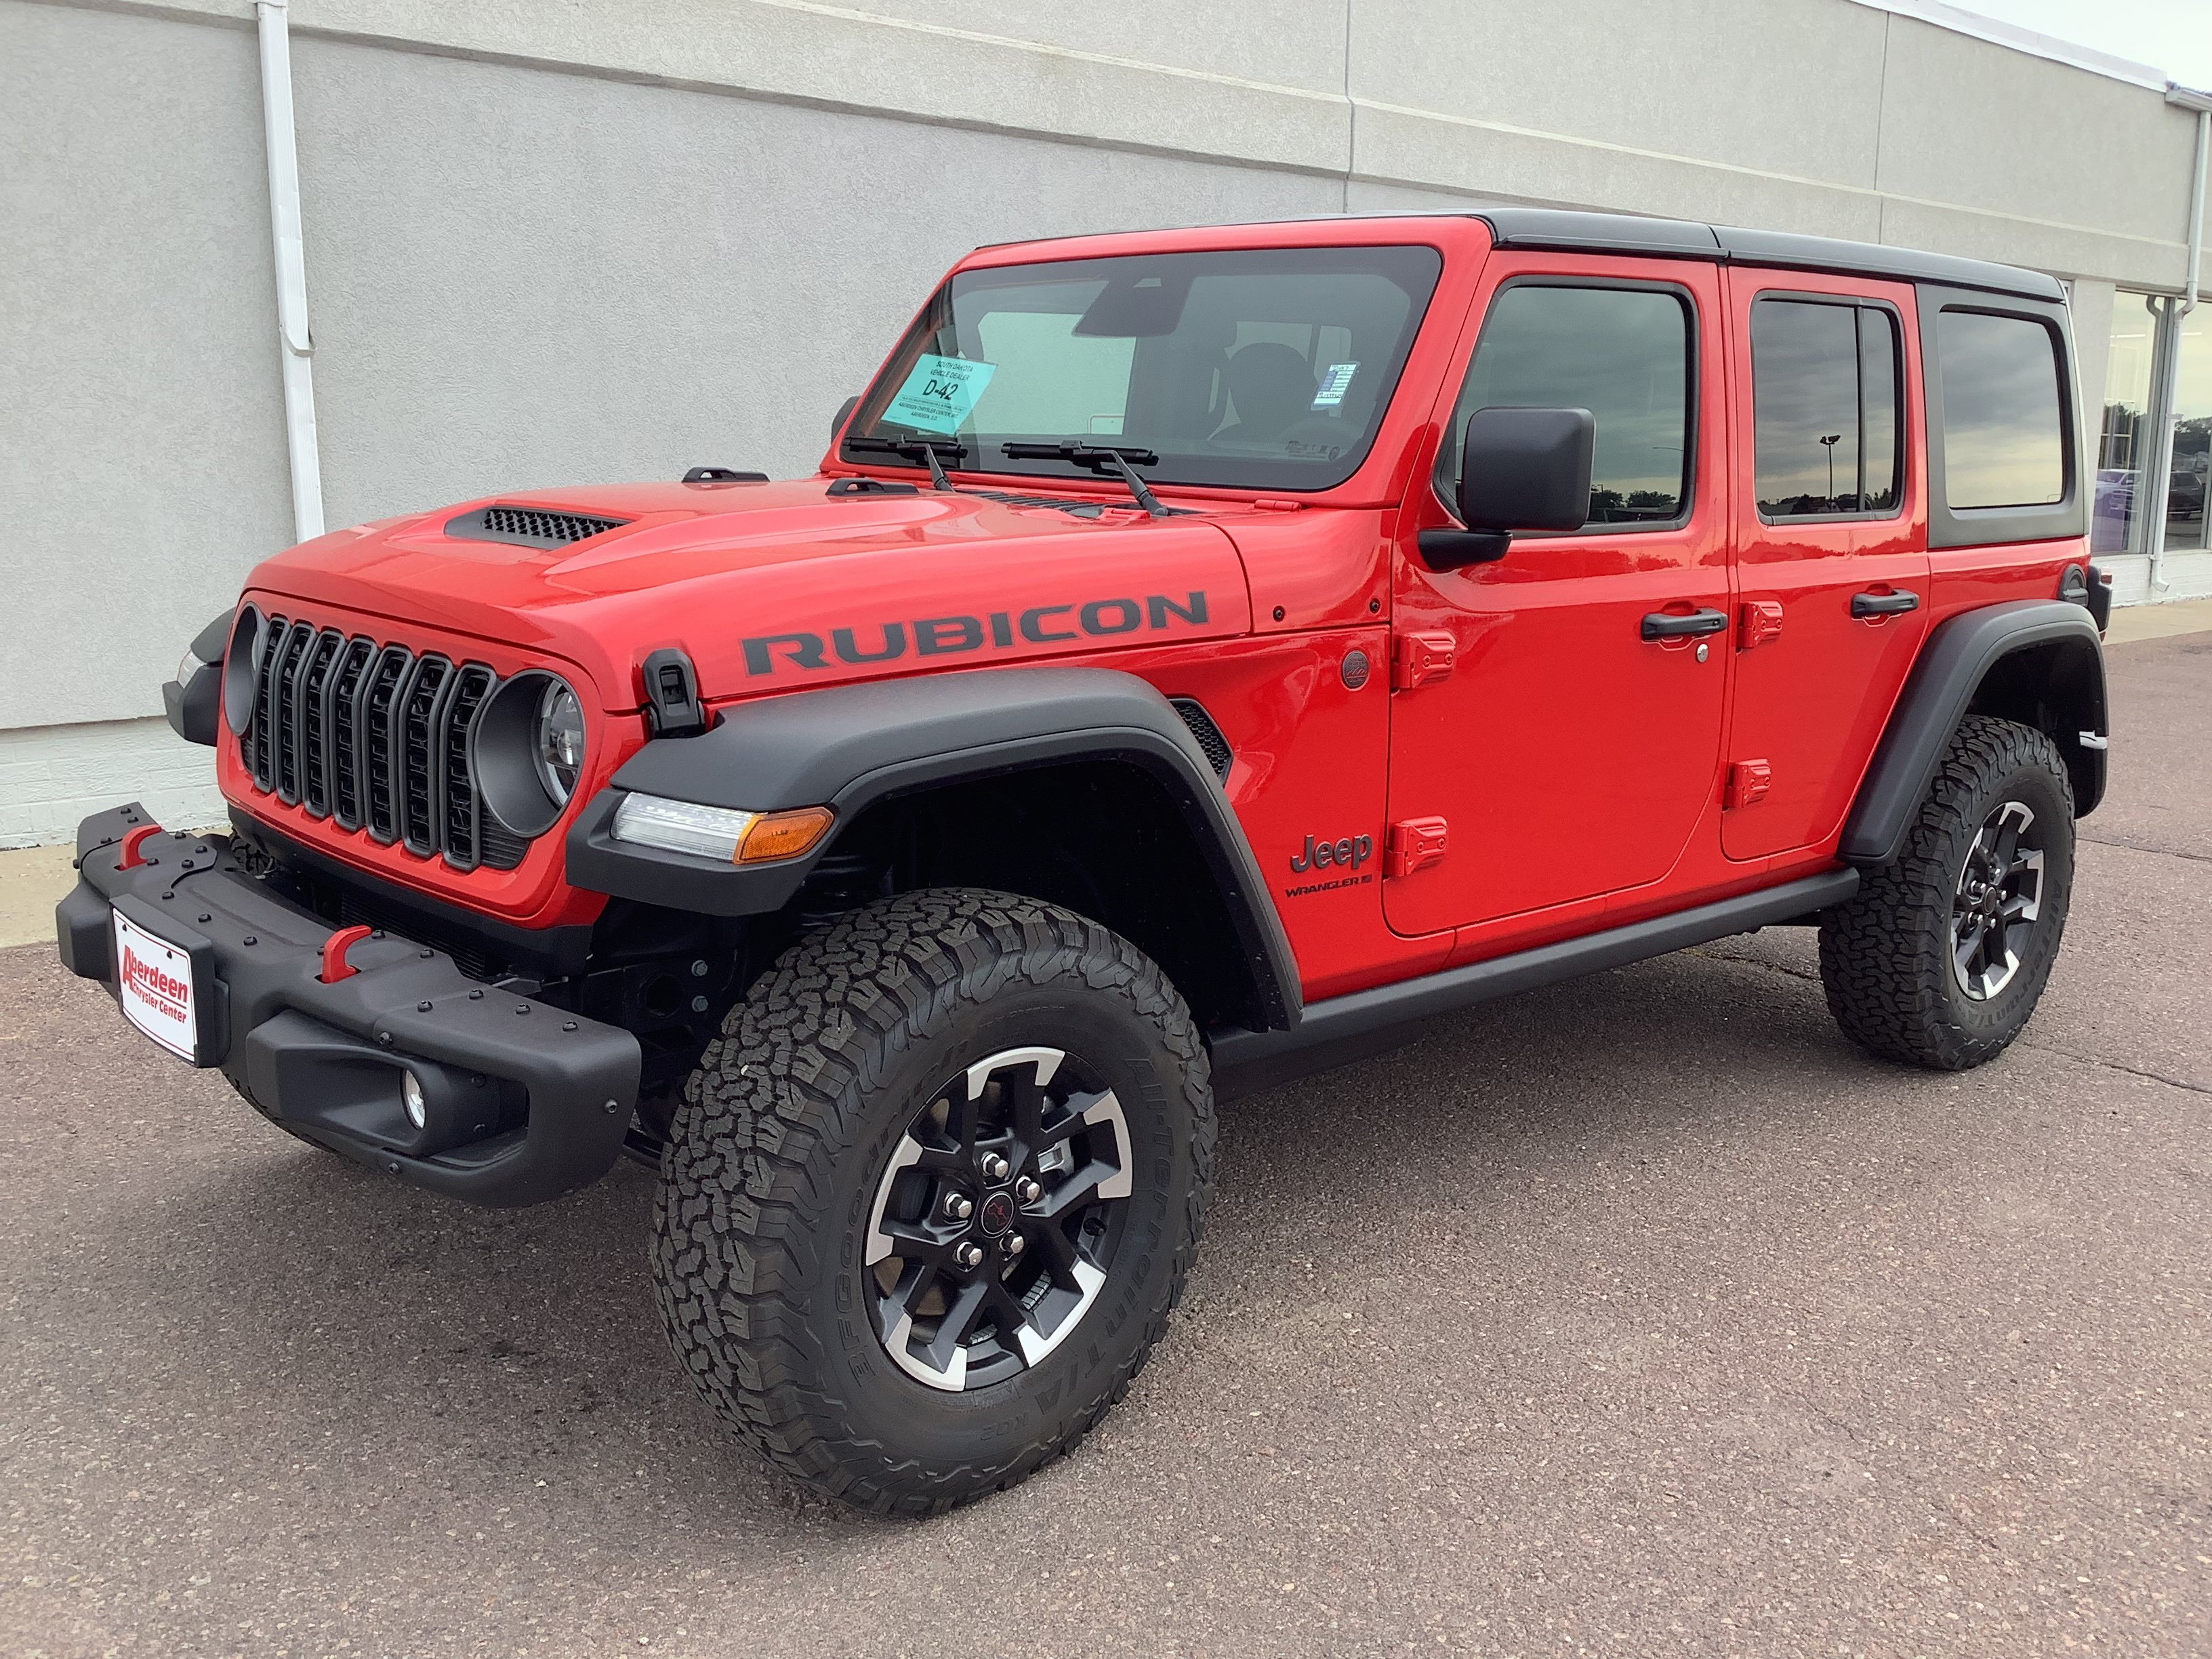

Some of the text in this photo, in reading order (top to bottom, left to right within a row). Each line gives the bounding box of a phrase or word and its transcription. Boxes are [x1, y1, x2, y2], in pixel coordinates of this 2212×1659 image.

[930, 369, 970, 381] VEHICLE DEALER
[953, 363, 974, 372] DAKOTA
[922, 379, 959, 401] D-42
[741, 591, 1210, 676] RUBICON
[1291, 834, 1372, 873] Jeep
[1285, 876, 1359, 899] WRANGLER
[123, 944, 188, 1004] Aberdeen
[159, 999, 187, 1024] Center
